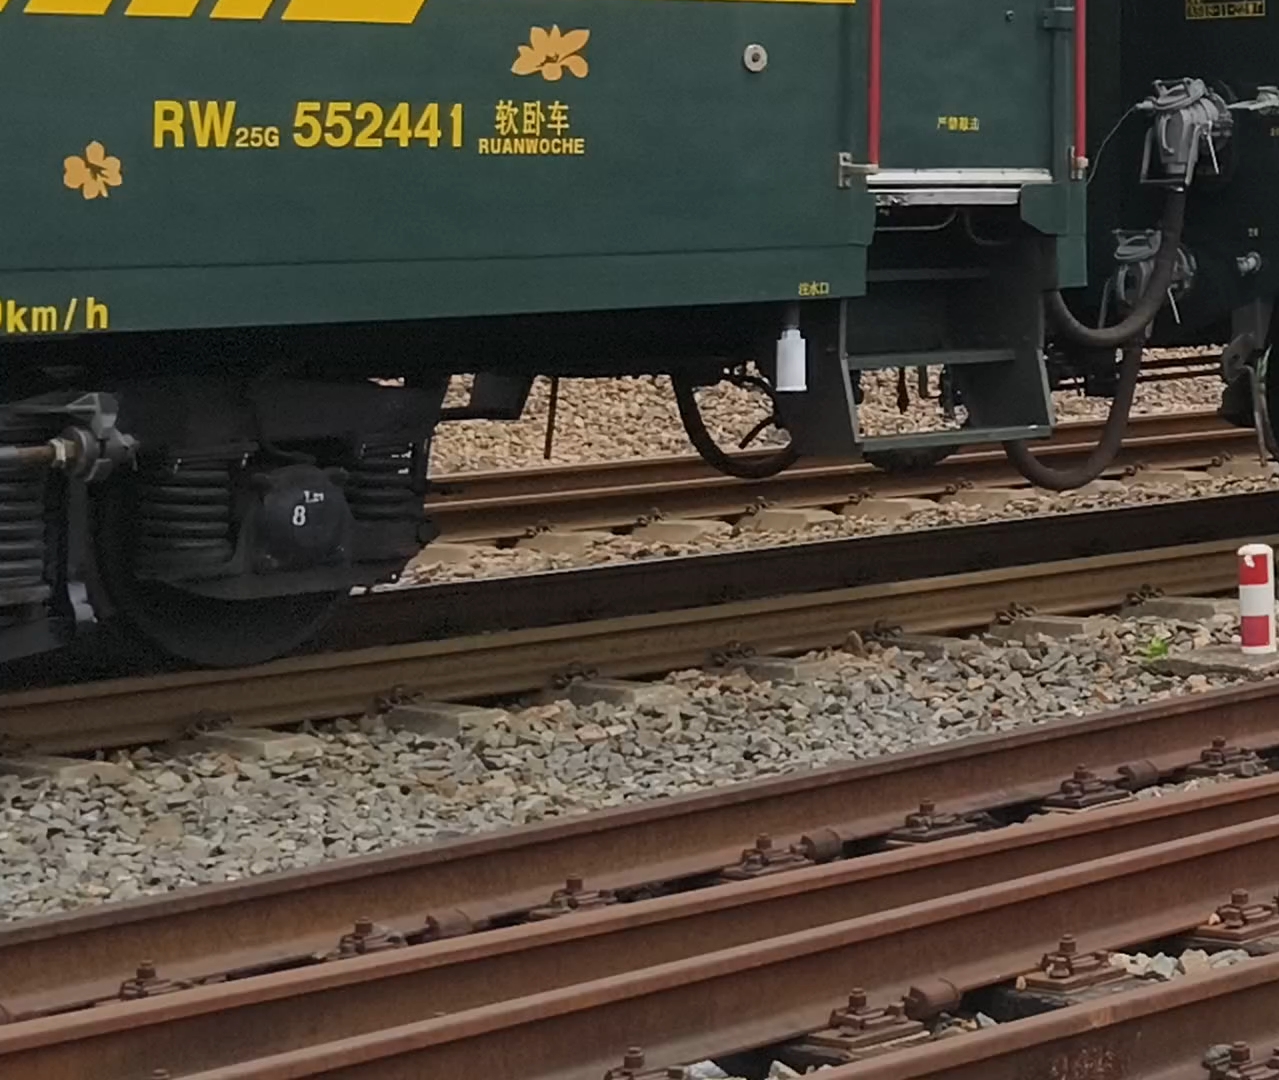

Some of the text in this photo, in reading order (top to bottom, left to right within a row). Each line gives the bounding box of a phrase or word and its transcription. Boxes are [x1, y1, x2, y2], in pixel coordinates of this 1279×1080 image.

[293, 101, 463, 148] 552441
[494, 99, 570, 137] 软卧车
[478, 137, 585, 155] RUANWOCHE
[0, 296, 108, 333] km/h
[292, 505, 306, 526] 8
